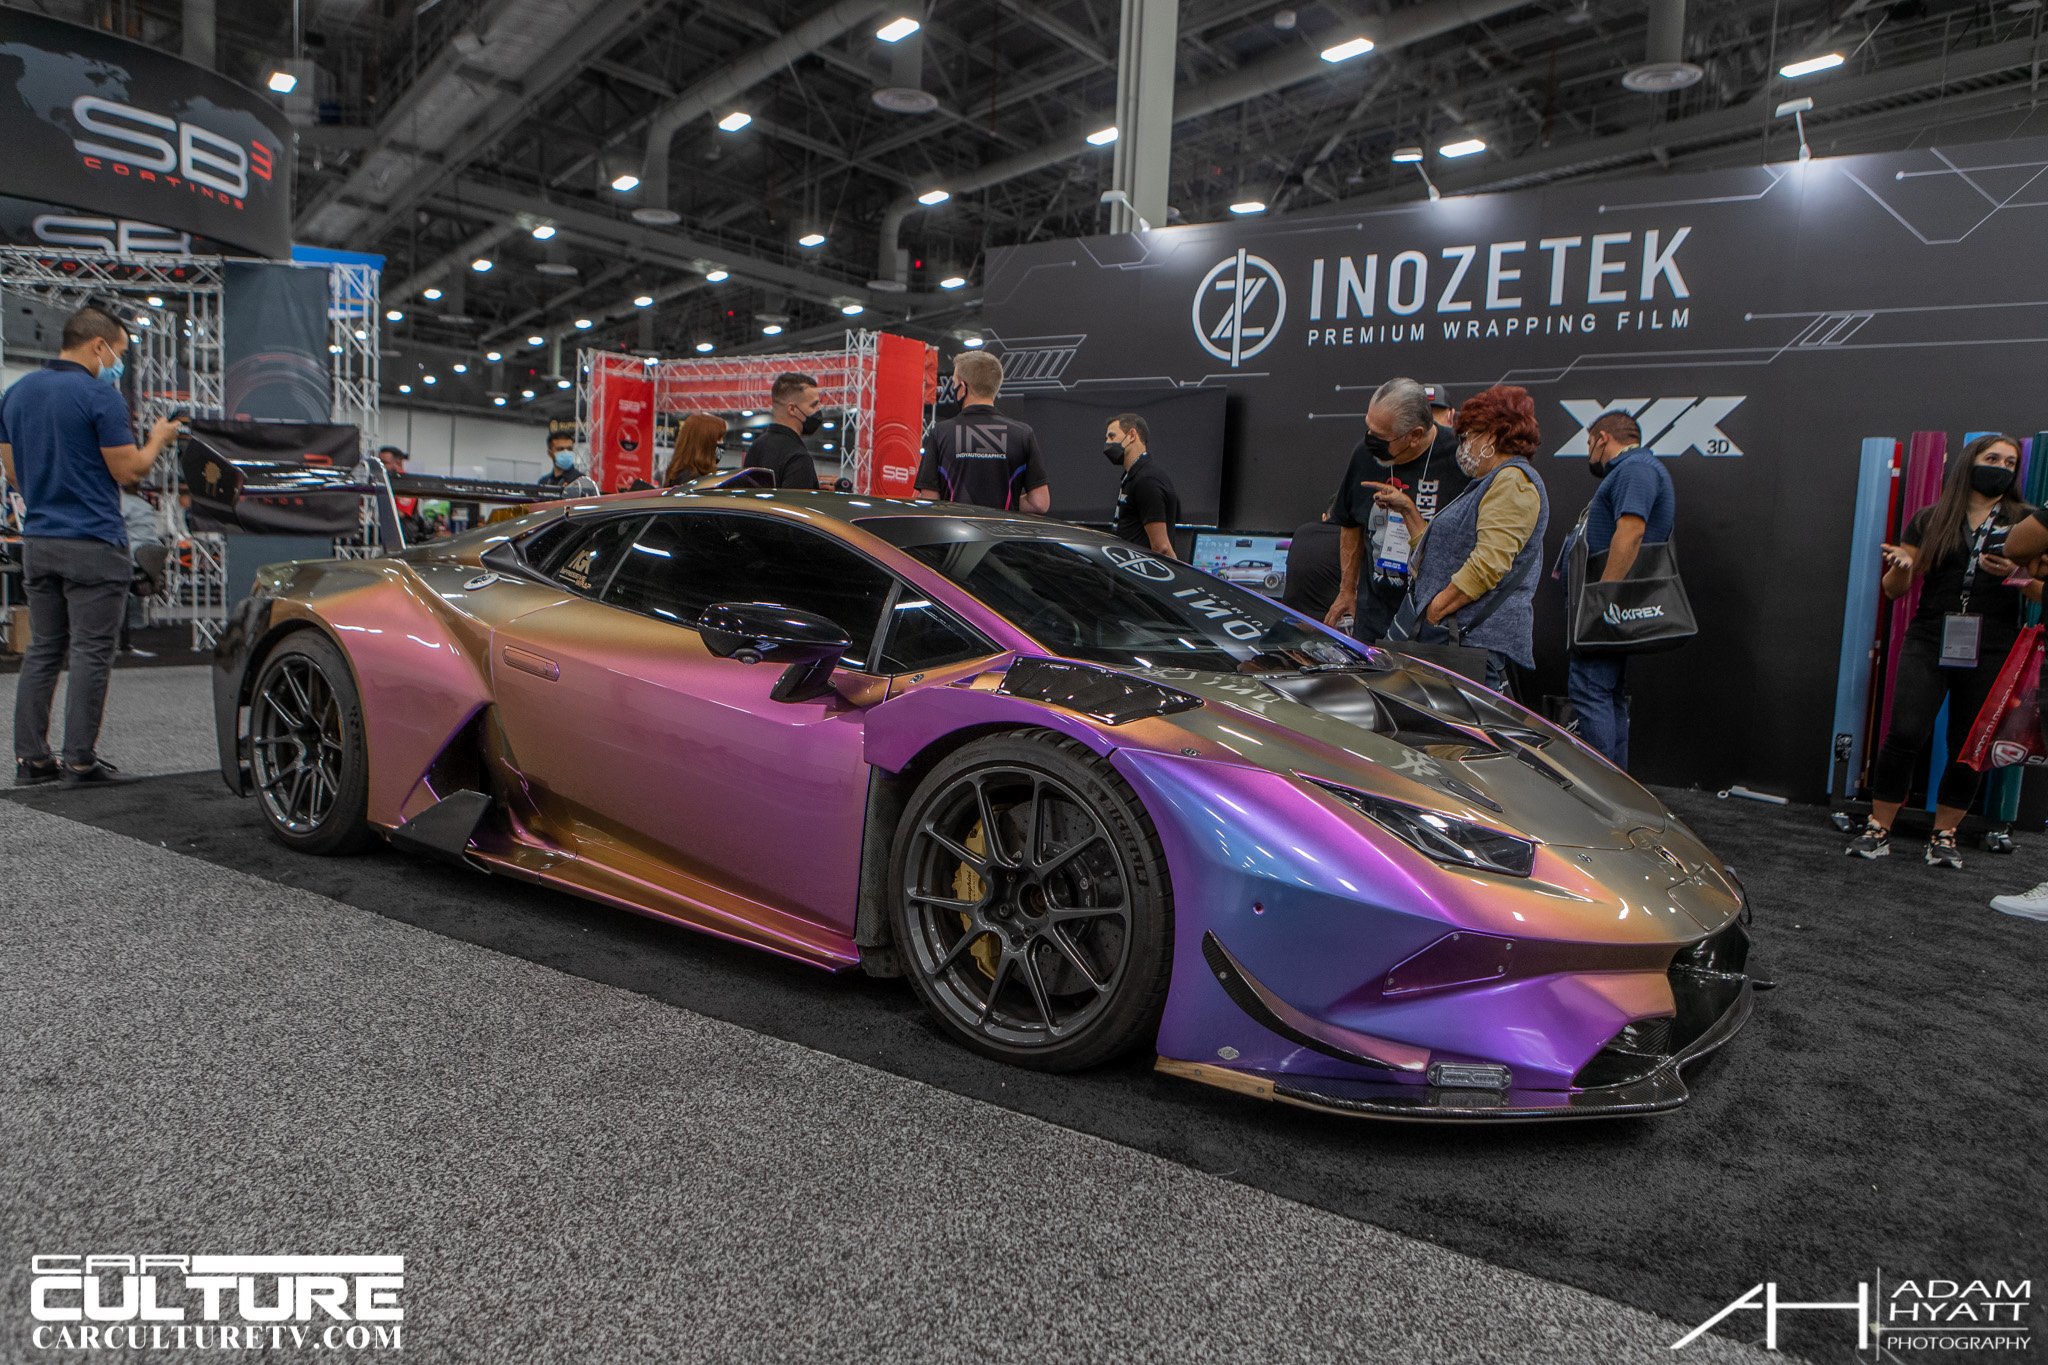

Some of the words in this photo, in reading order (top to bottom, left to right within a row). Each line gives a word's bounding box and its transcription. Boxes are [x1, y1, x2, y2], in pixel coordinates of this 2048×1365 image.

[83, 156, 244, 210] COATINGS
[1309, 226, 1693, 321] INOZETEK
[1307, 322, 1425, 347] PREMIUM
[1443, 313, 1597, 340] WRAPPING
[1617, 308, 1691, 331] FILM
[1706, 438, 1730, 455] 3D
